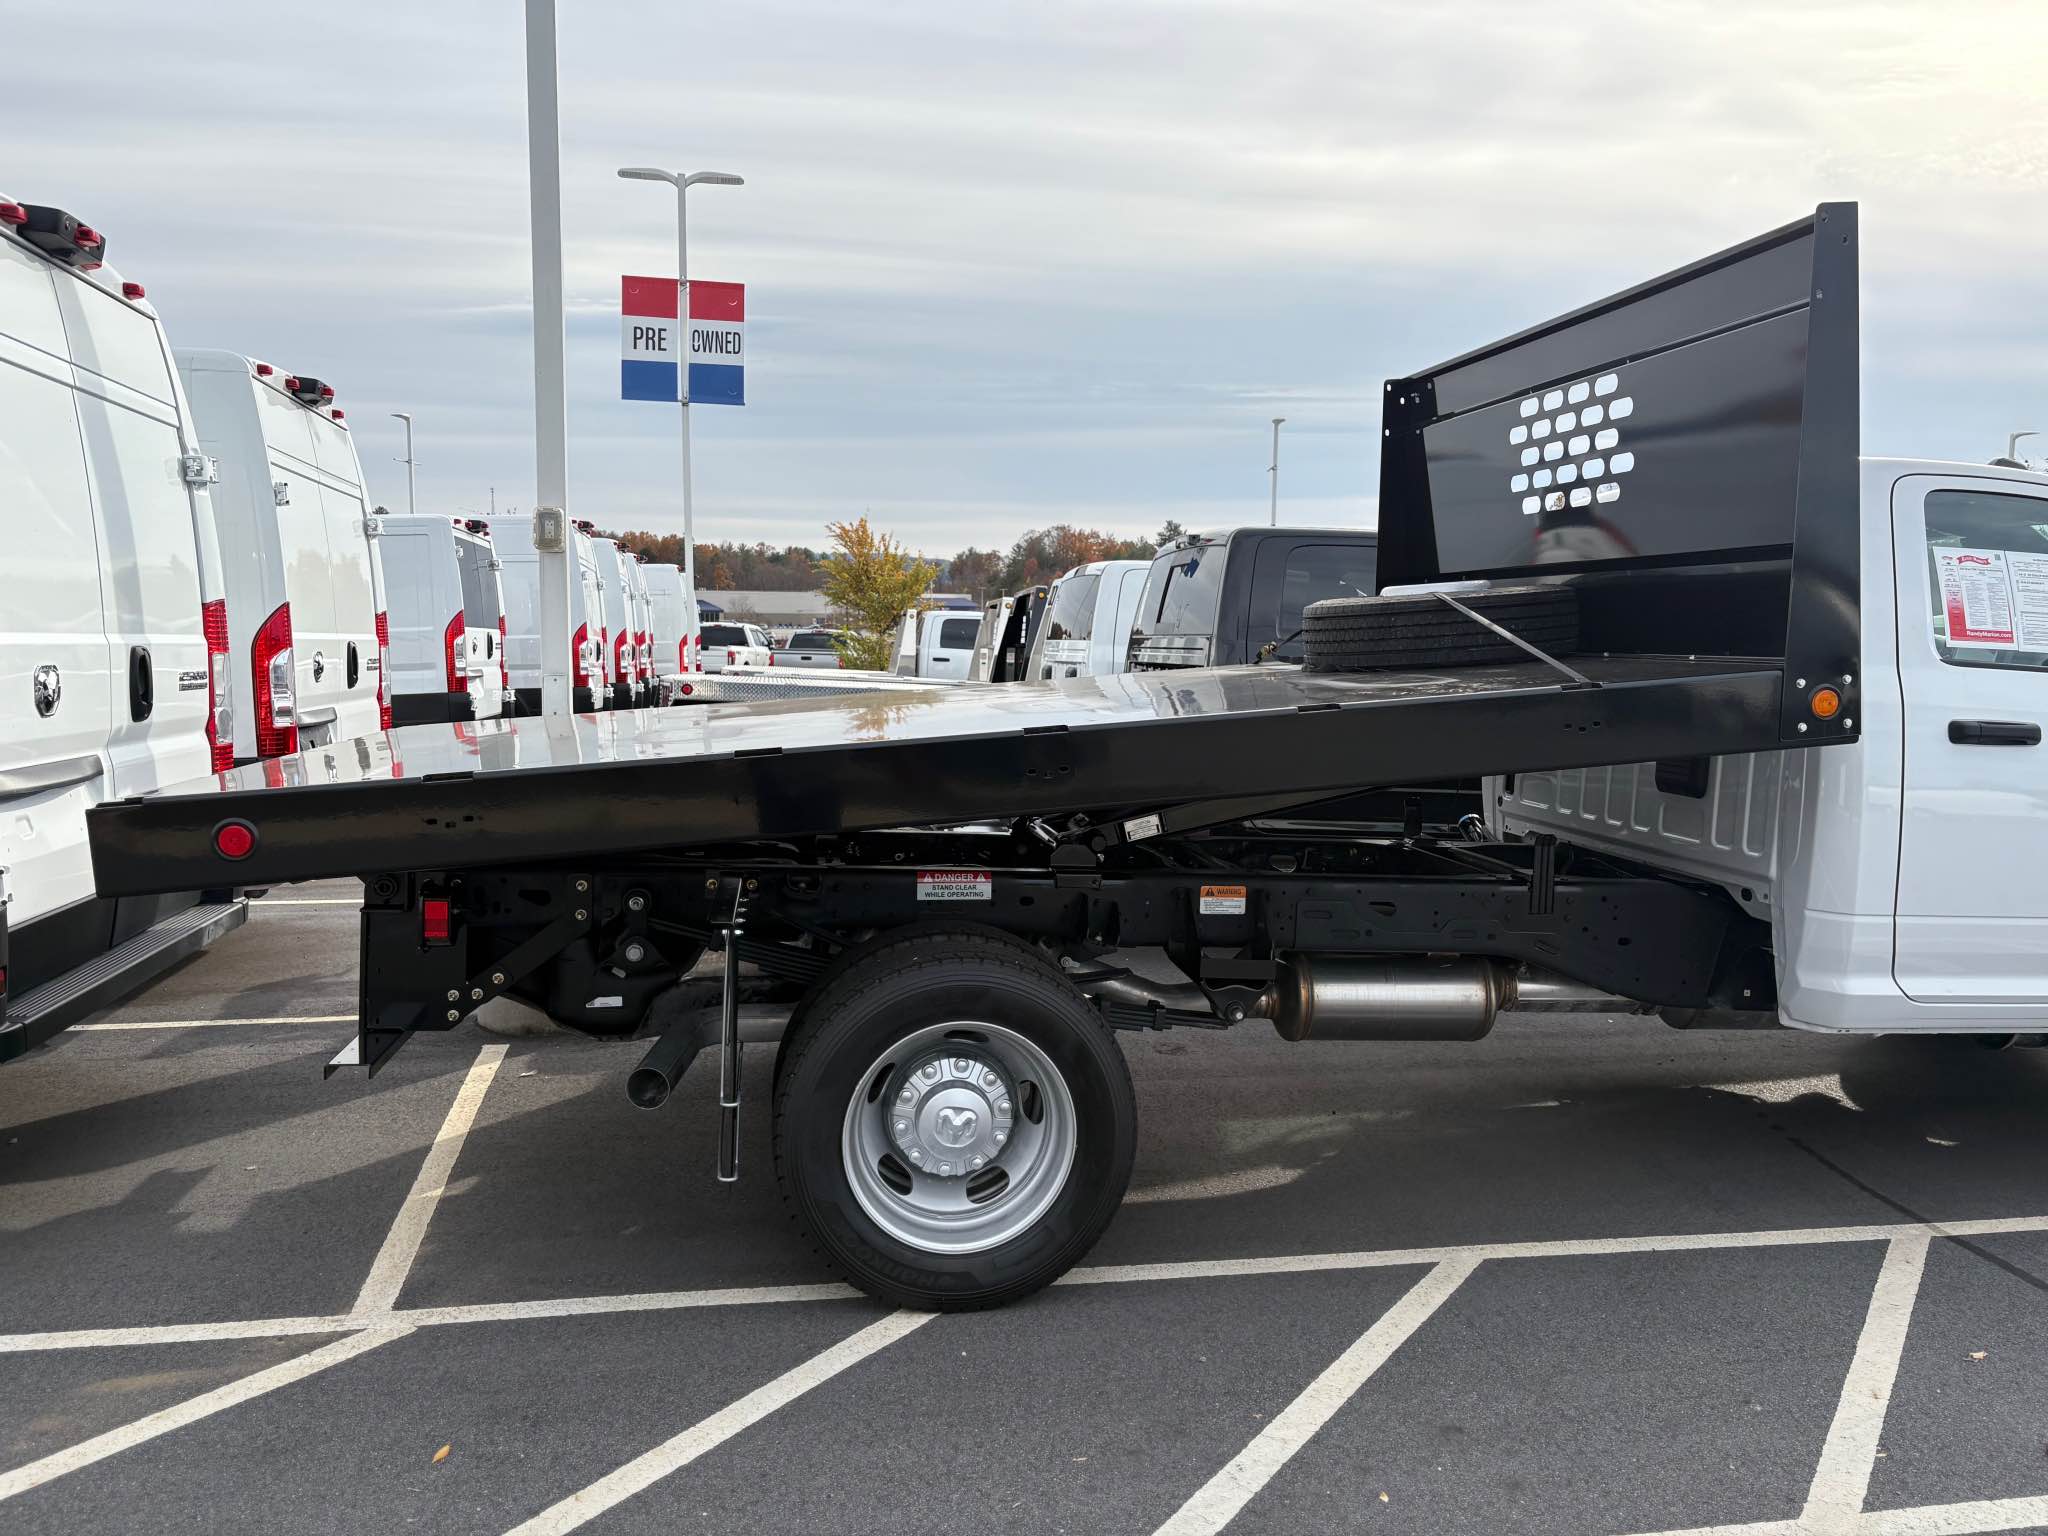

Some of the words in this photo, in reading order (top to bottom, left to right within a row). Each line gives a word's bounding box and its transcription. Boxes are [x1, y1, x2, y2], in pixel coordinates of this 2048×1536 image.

[633, 326, 667, 351] PRE
[692, 329, 741, 354] OWNED
[934, 873, 974, 882] DANGER
